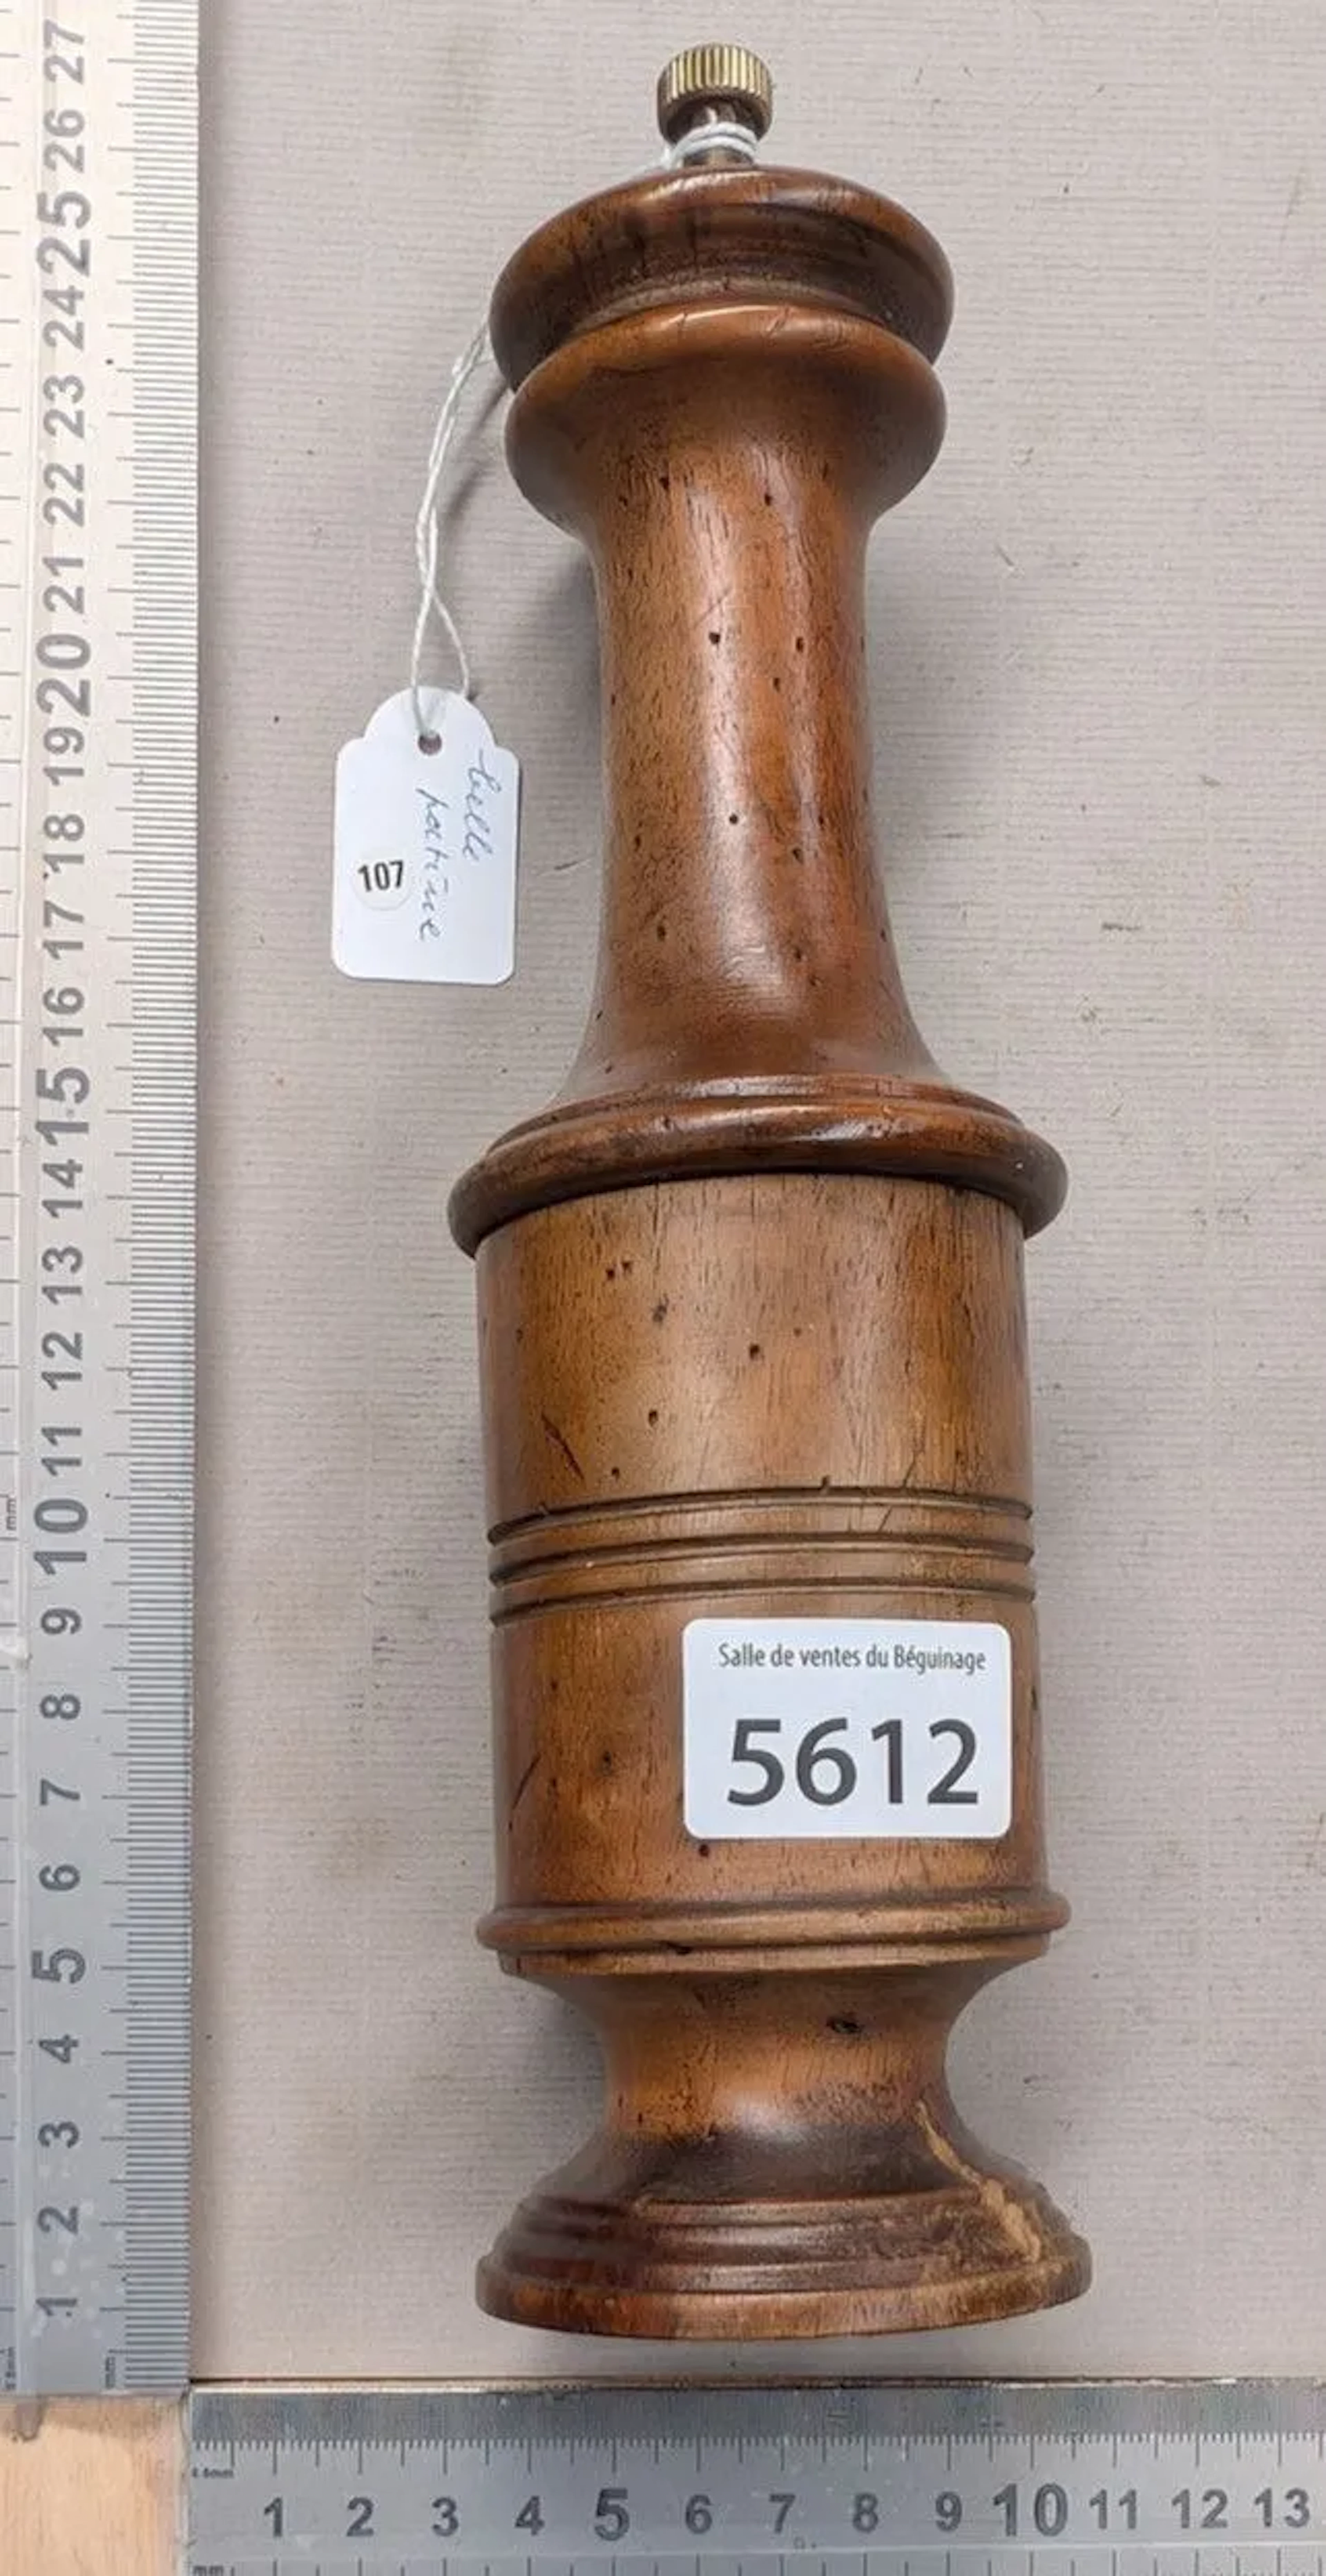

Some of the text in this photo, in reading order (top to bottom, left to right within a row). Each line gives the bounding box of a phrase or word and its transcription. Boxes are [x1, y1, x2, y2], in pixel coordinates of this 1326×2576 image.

[357, 859, 404, 892] 107
[31, 18, 92, 2317] 1 2 3 4 5 6 7 8 9 10 11 12 13 14 15 16 17 18 19 20 21 22 23 24 25 26 27
[718, 1642, 986, 1676] Salle de ventes du Béguinage
[727, 1717, 978, 1807] 5612
[263, 2482, 1311, 2542] 1 2 3 4 5 6 7 8 9 10 11 12 13
